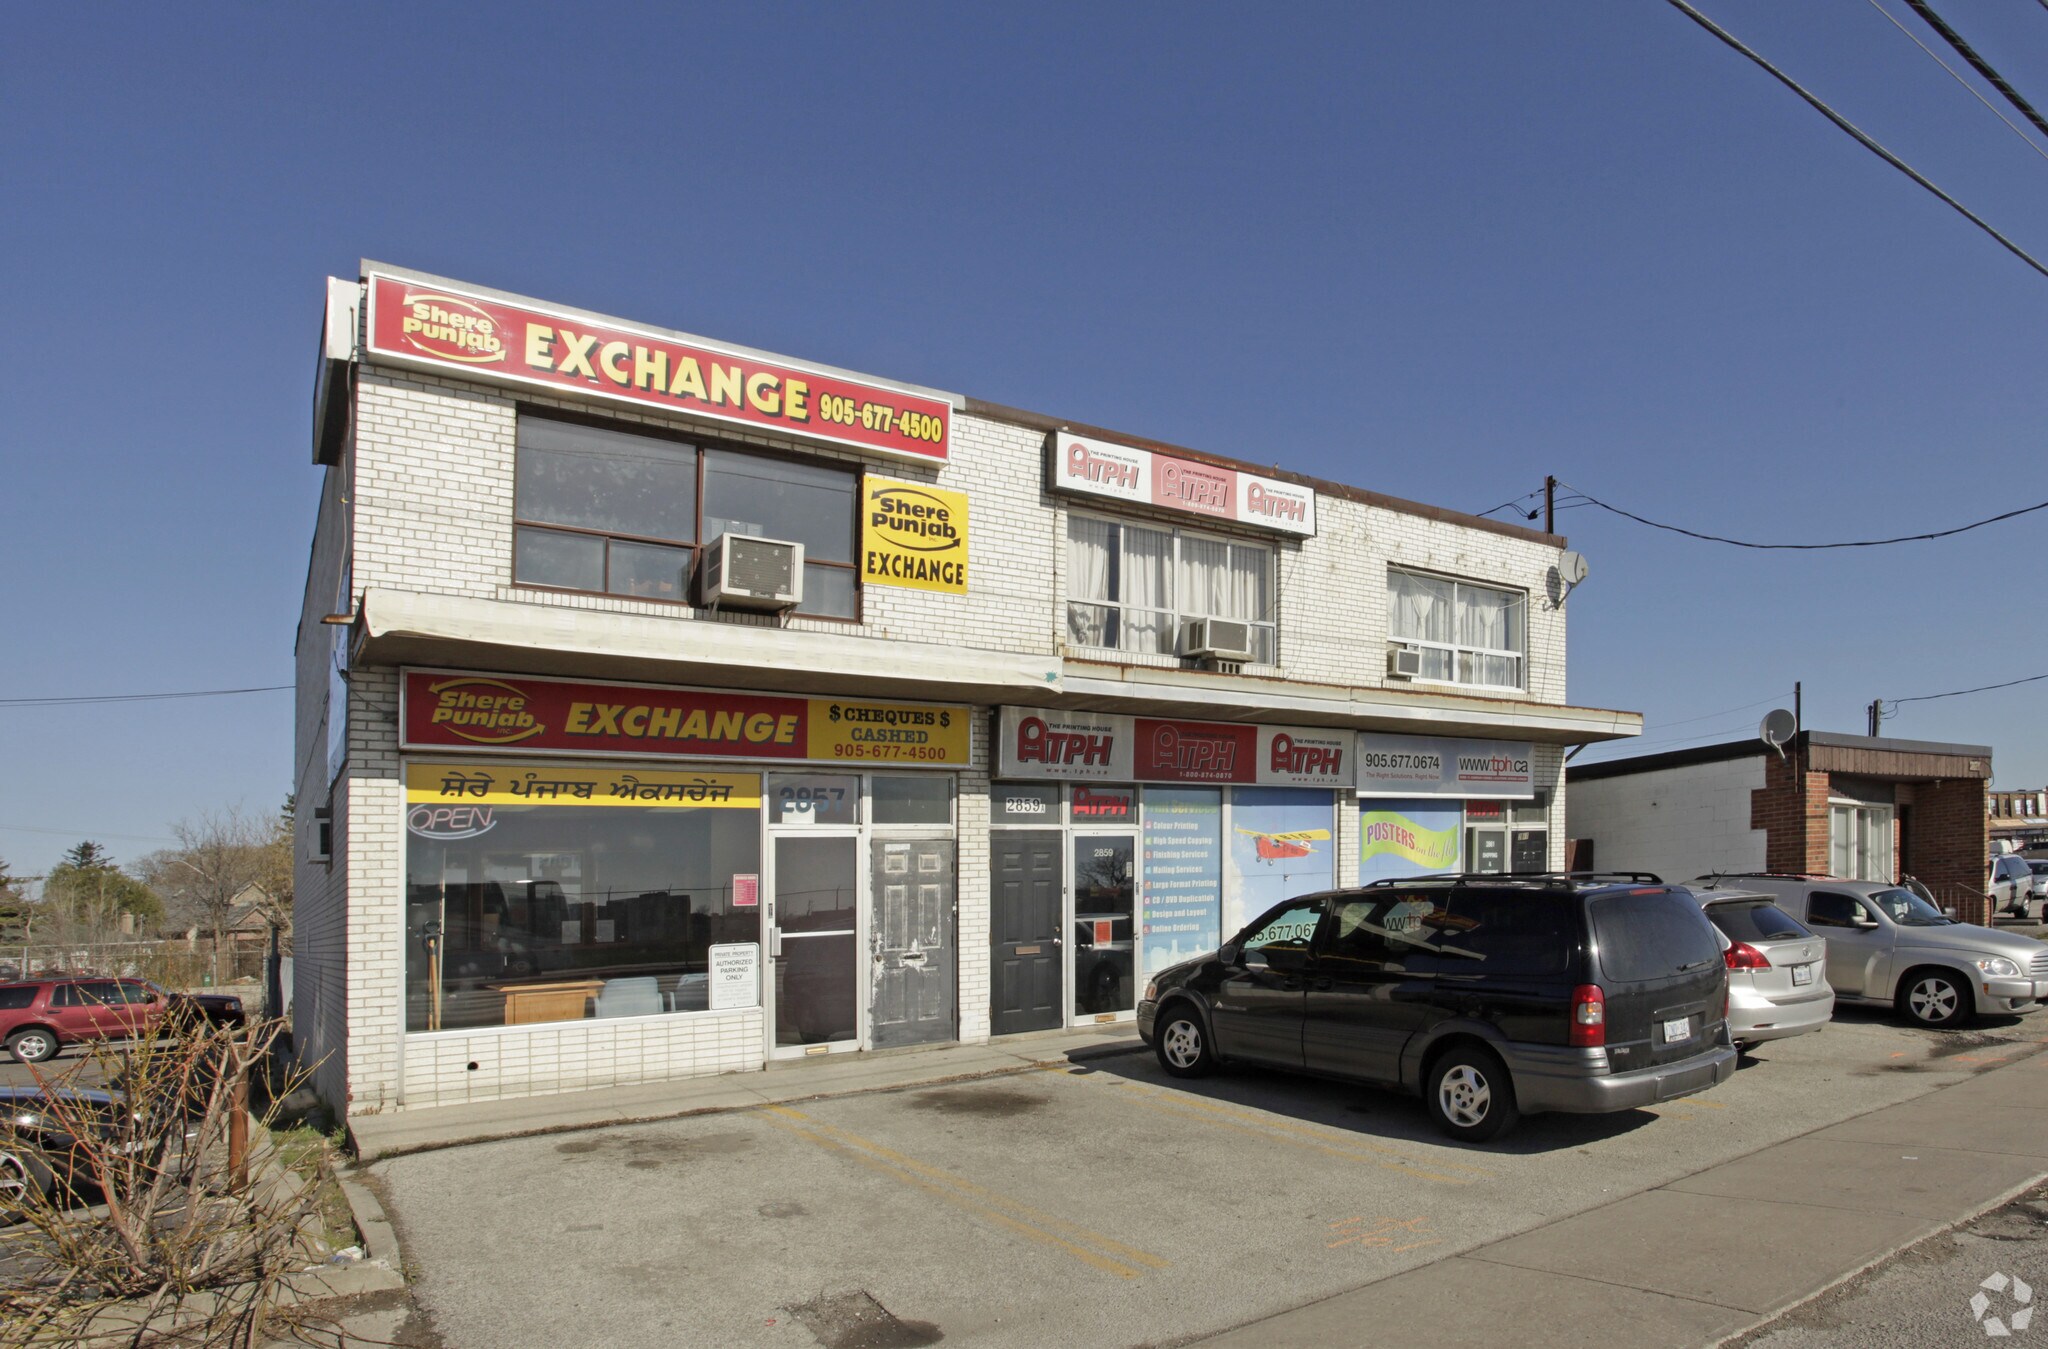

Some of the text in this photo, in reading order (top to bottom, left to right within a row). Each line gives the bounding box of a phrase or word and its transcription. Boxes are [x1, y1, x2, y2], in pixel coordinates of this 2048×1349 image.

[413, 303, 493, 334] Shere
[403, 316, 501, 353] Punjab
[525, 322, 943, 444] EXCHANGE 905-677-4500
[1100, 452, 1122, 460] PRINTING
[1192, 471, 1211, 479] PRINTING
[880, 497, 949, 521] Shere
[872, 512, 956, 538] Punjab
[867, 551, 964, 586] EXCHANGE
[438, 691, 525, 711] Shere
[432, 707, 535, 728] Punjab
[564, 702, 799, 745] EXCHANGE
[829, 704, 951, 728] $ CHEQUES $
[851, 727, 929, 744] CASHED
[834, 743, 947, 760] 905-677-4500
[1365, 753, 1528, 776] 905.677.0674 www.tph.ca
[1376, 772, 1389, 780] Right
[779, 787, 845, 814] 2857
[407, 807, 493, 831] OPEN
[1153, 821, 1199, 831] Colour Printing
[1153, 836, 1213, 846] High Speed Copying
[1367, 822, 1416, 851] POSTERS
[1416, 846, 1426, 855] on
[1427, 842, 1439, 858] the
[1094, 848, 1114, 857] 2859
[1153, 850, 1208, 859] Finishing Services
[1153, 865, 1203, 875] Mailing Services
[1152, 880, 1217, 889] Large Format Printing
[1152, 896, 1161, 904] CD
[1165, 896, 1178, 904] DVD
[1178, 895, 1215, 903] Duplication
[1151, 908, 1207, 918] Design and Layout
[1151, 924, 1200, 933] Online Ordering
[716, 958, 753, 967] AUTHORIZED
[720, 966, 748, 974] PARKING
